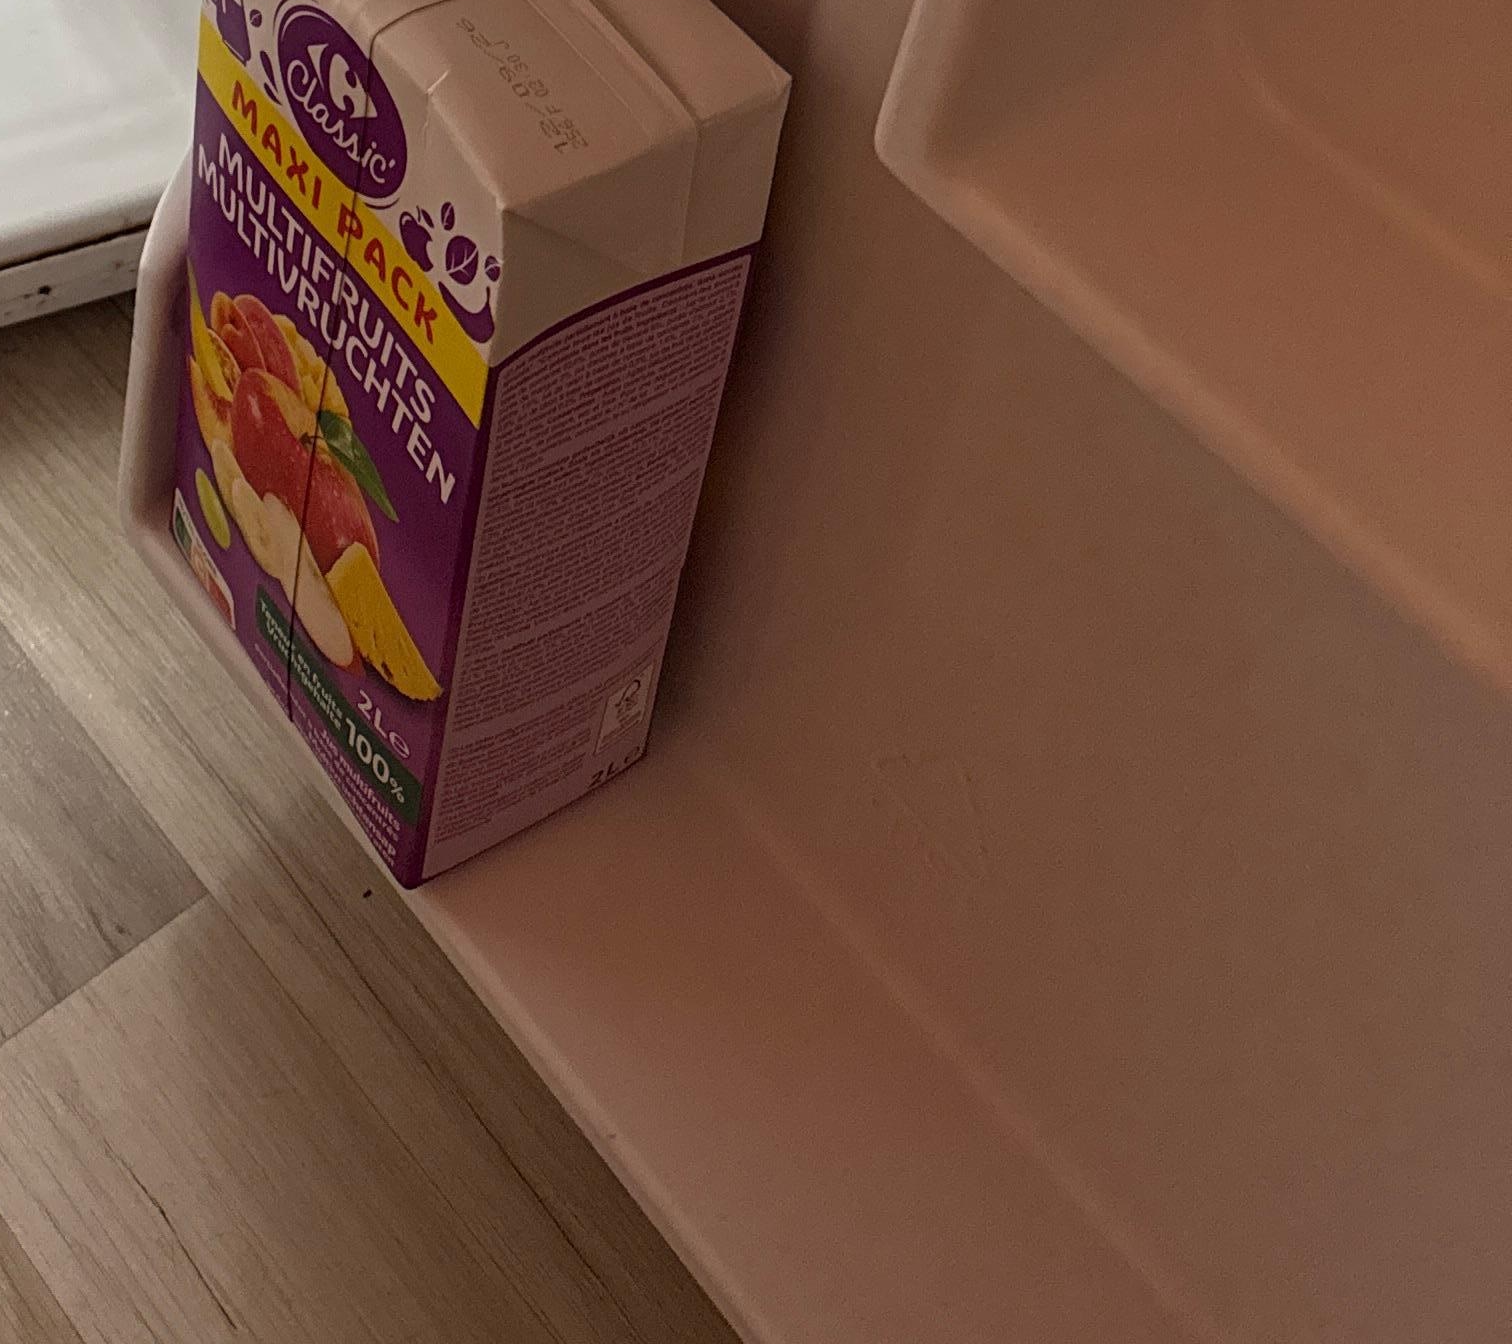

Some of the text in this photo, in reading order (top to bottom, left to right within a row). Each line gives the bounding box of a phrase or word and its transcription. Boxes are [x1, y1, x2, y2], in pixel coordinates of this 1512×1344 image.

[231, 80, 440, 344] MAXI PACK
[287, 58, 393, 184] Classic
[198, 144, 456, 505] MULTIVRUCHTEN
[219, 133, 436, 423] MULTIFRUITS
[345, 716, 405, 804] 100%
